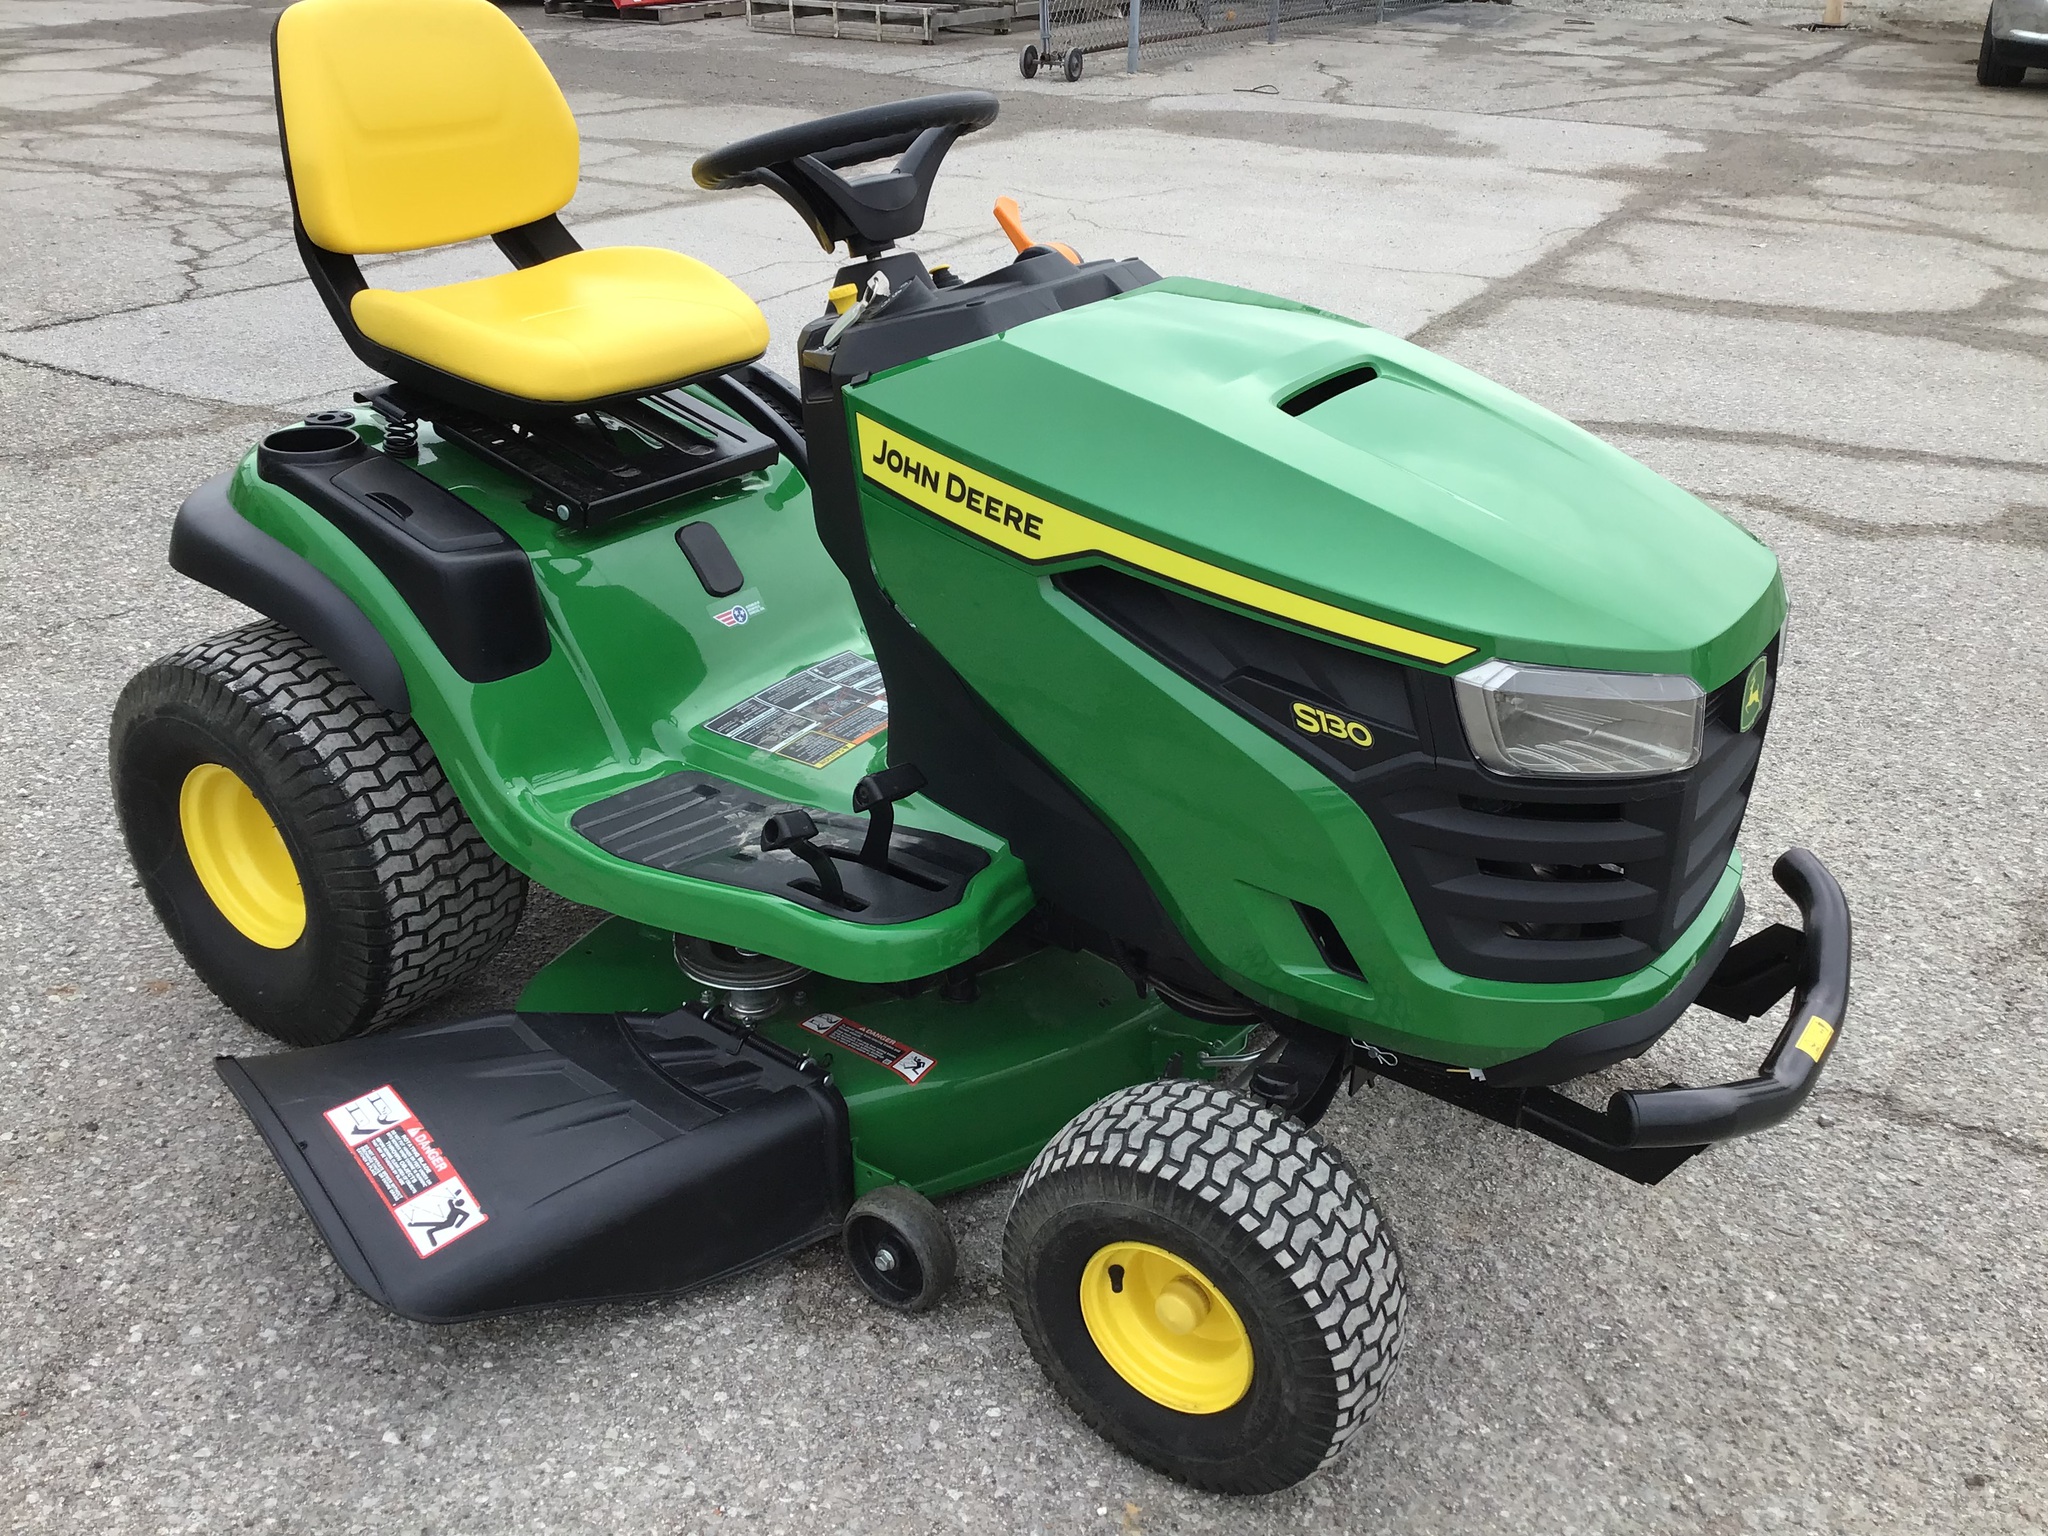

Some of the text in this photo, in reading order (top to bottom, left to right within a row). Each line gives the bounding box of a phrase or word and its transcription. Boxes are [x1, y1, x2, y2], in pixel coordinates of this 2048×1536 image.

[873, 440, 1043, 540] JOHN DEERE
[1293, 703, 1372, 747] S130
[865, 1029, 896, 1045] DANGER
[385, 1140, 402, 1161] THROWN
[398, 1160, 417, 1183] OBJECTS
[400, 1134, 420, 1157] ROTATING
[416, 1156, 431, 1173] BLADE
[416, 1134, 448, 1172] DANGER
